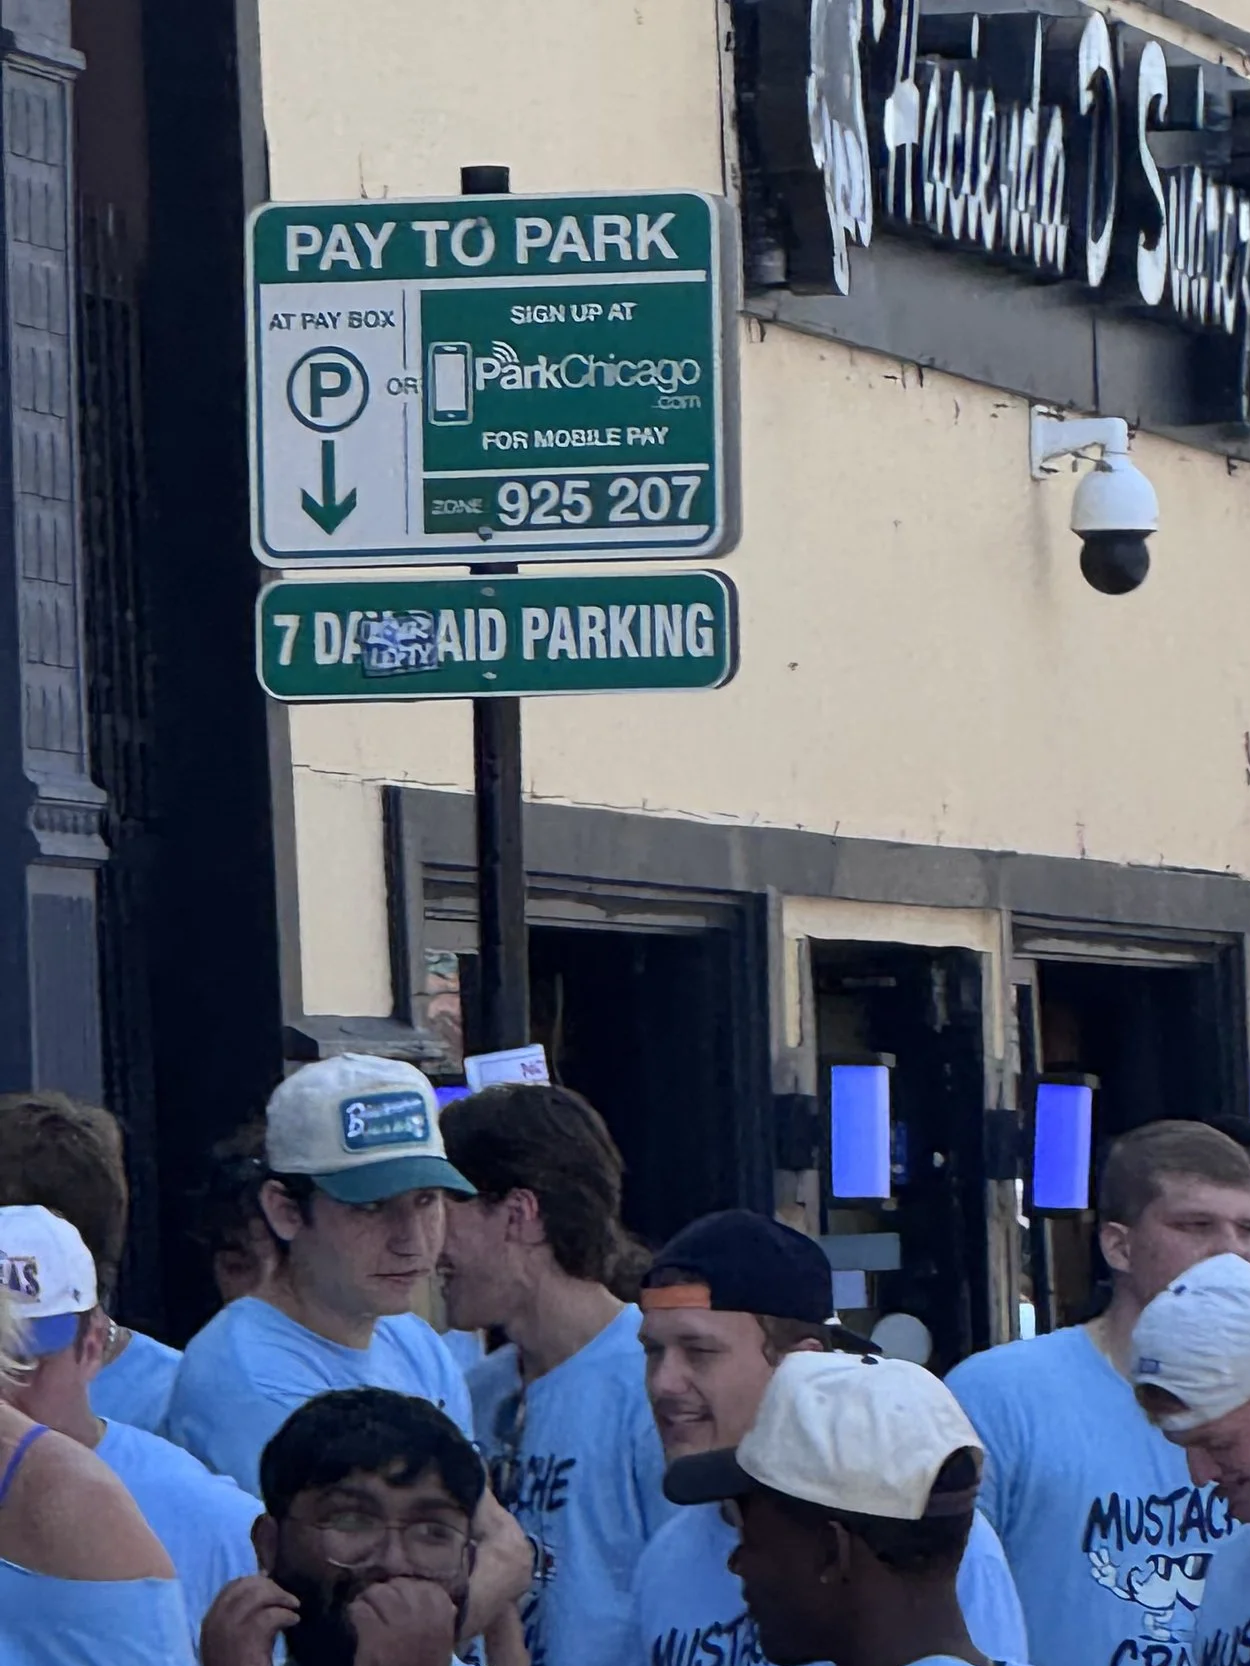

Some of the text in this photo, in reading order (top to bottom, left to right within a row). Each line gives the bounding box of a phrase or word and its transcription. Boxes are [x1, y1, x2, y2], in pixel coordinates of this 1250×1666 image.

[286, 212, 679, 272] PAY TO PARK
[268, 310, 396, 331] AT PAY BOX
[509, 302, 638, 325] SIGN UP AT
[386, 376, 420, 396] OR
[482, 426, 669, 451] FOR MOBILE PAY
[497, 479, 593, 526] 925
[607, 475, 702, 523] 207
[273, 613, 301, 666] 7
[313, 610, 392, 665] DA
[521, 602, 715, 661] PARKING
[1082, 1484, 1233, 1553] MUSTAC
